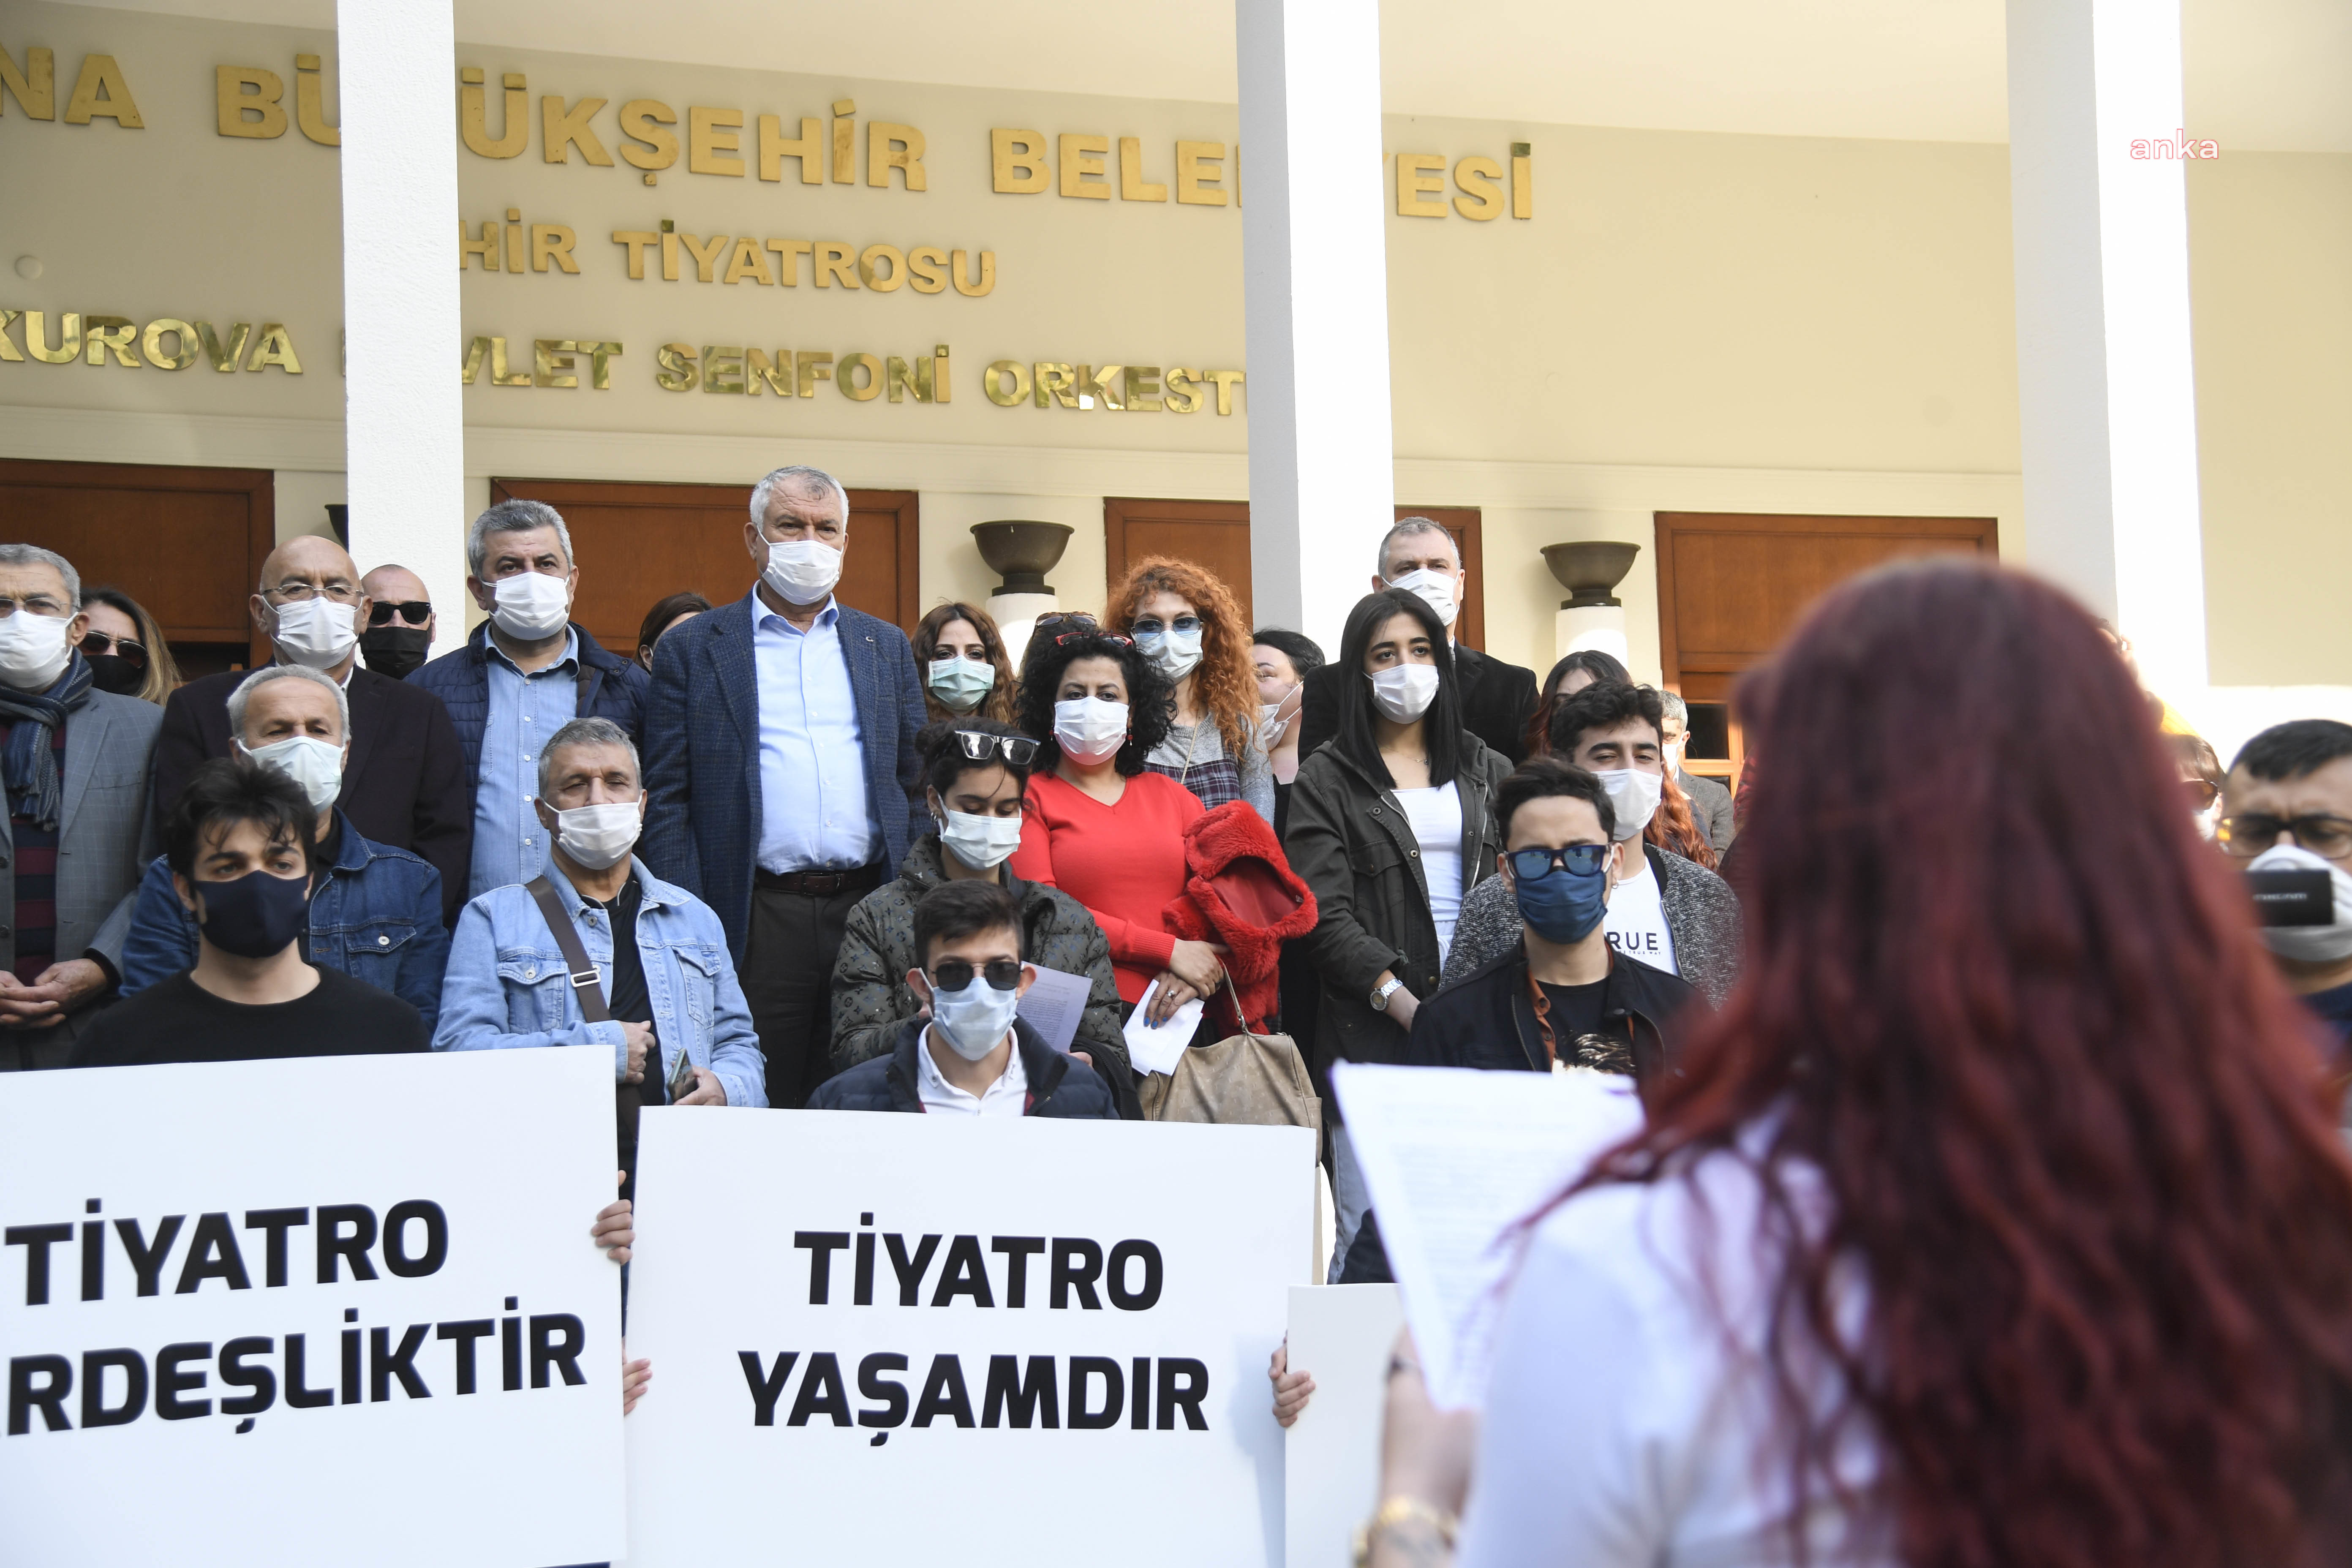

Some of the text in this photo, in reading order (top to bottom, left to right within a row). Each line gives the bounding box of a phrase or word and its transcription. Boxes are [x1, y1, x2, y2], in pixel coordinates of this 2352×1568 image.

[216, 54, 927, 191] BÜÜKŞEHİR
[991, 128, 1532, 221] BELEESİ
[459, 208, 996, 297] HİR TİYATROSU
[657, 343, 950, 403] SENFONİ
[984, 359, 1247, 416] ORKEST
[1606, 932, 1658, 950] RUE
[4, 1198, 449, 1306] TİYATRO
[794, 1211, 1163, 1312] TİYATRO
[8, 1295, 588, 1436] RDEŞLİKTİR
[737, 1350, 1210, 1447] YAŞAMDIR
